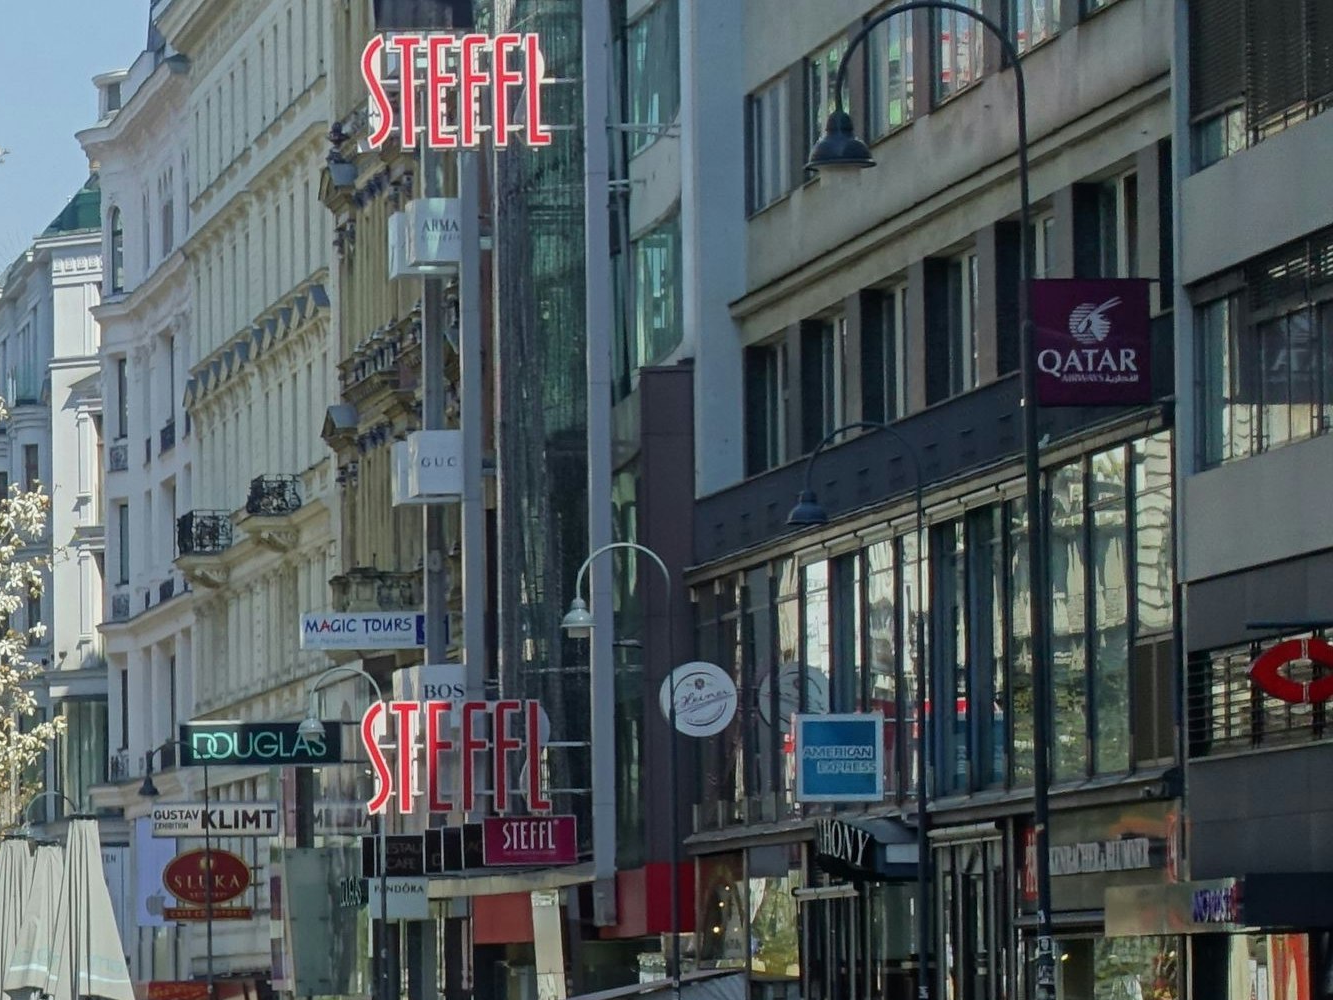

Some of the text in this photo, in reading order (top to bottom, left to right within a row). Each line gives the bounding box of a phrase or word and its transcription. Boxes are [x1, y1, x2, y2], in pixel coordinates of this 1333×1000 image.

[361, 33, 552, 149] STEFFL
[1037, 348, 1138, 378] QATAR
[305, 618, 412, 634] MAGIC TOURS
[192, 731, 328, 760] DOUGLAS
[361, 699, 552, 815] STEFFL
[803, 745, 874, 759] AMERICAN
[817, 760, 877, 774] EXPRESS
[153, 809, 277, 829] GUSTAV KLIMT
[154, 822, 189, 830] EXHIBITION
[502, 821, 557, 850] STEFFL
